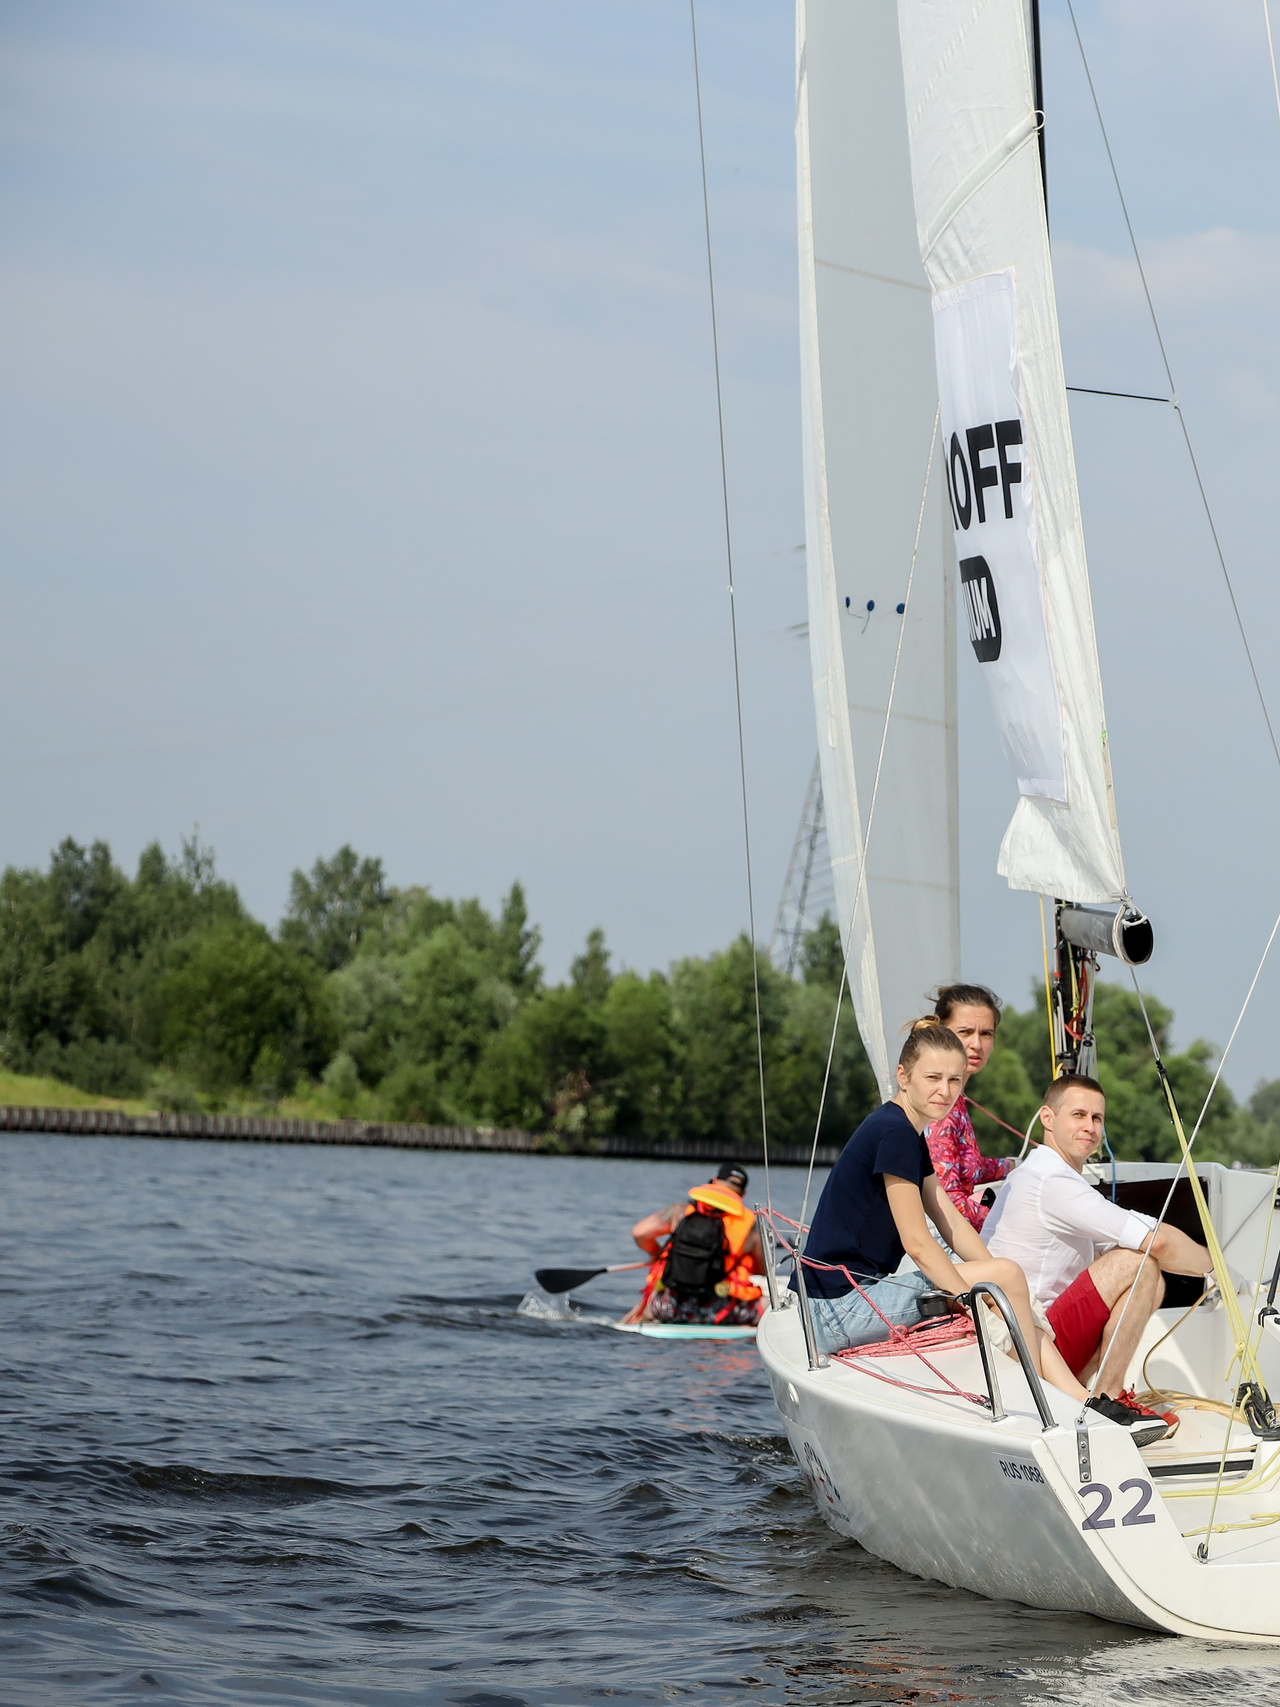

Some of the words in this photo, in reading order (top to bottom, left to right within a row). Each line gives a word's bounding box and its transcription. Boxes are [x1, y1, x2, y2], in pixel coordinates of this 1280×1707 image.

[943, 419, 1023, 531] OFF
[998, 1460, 1022, 1480] RUS
[1019, 1464, 1045, 1484] 1068
[1078, 1478, 1156, 1531] 22
